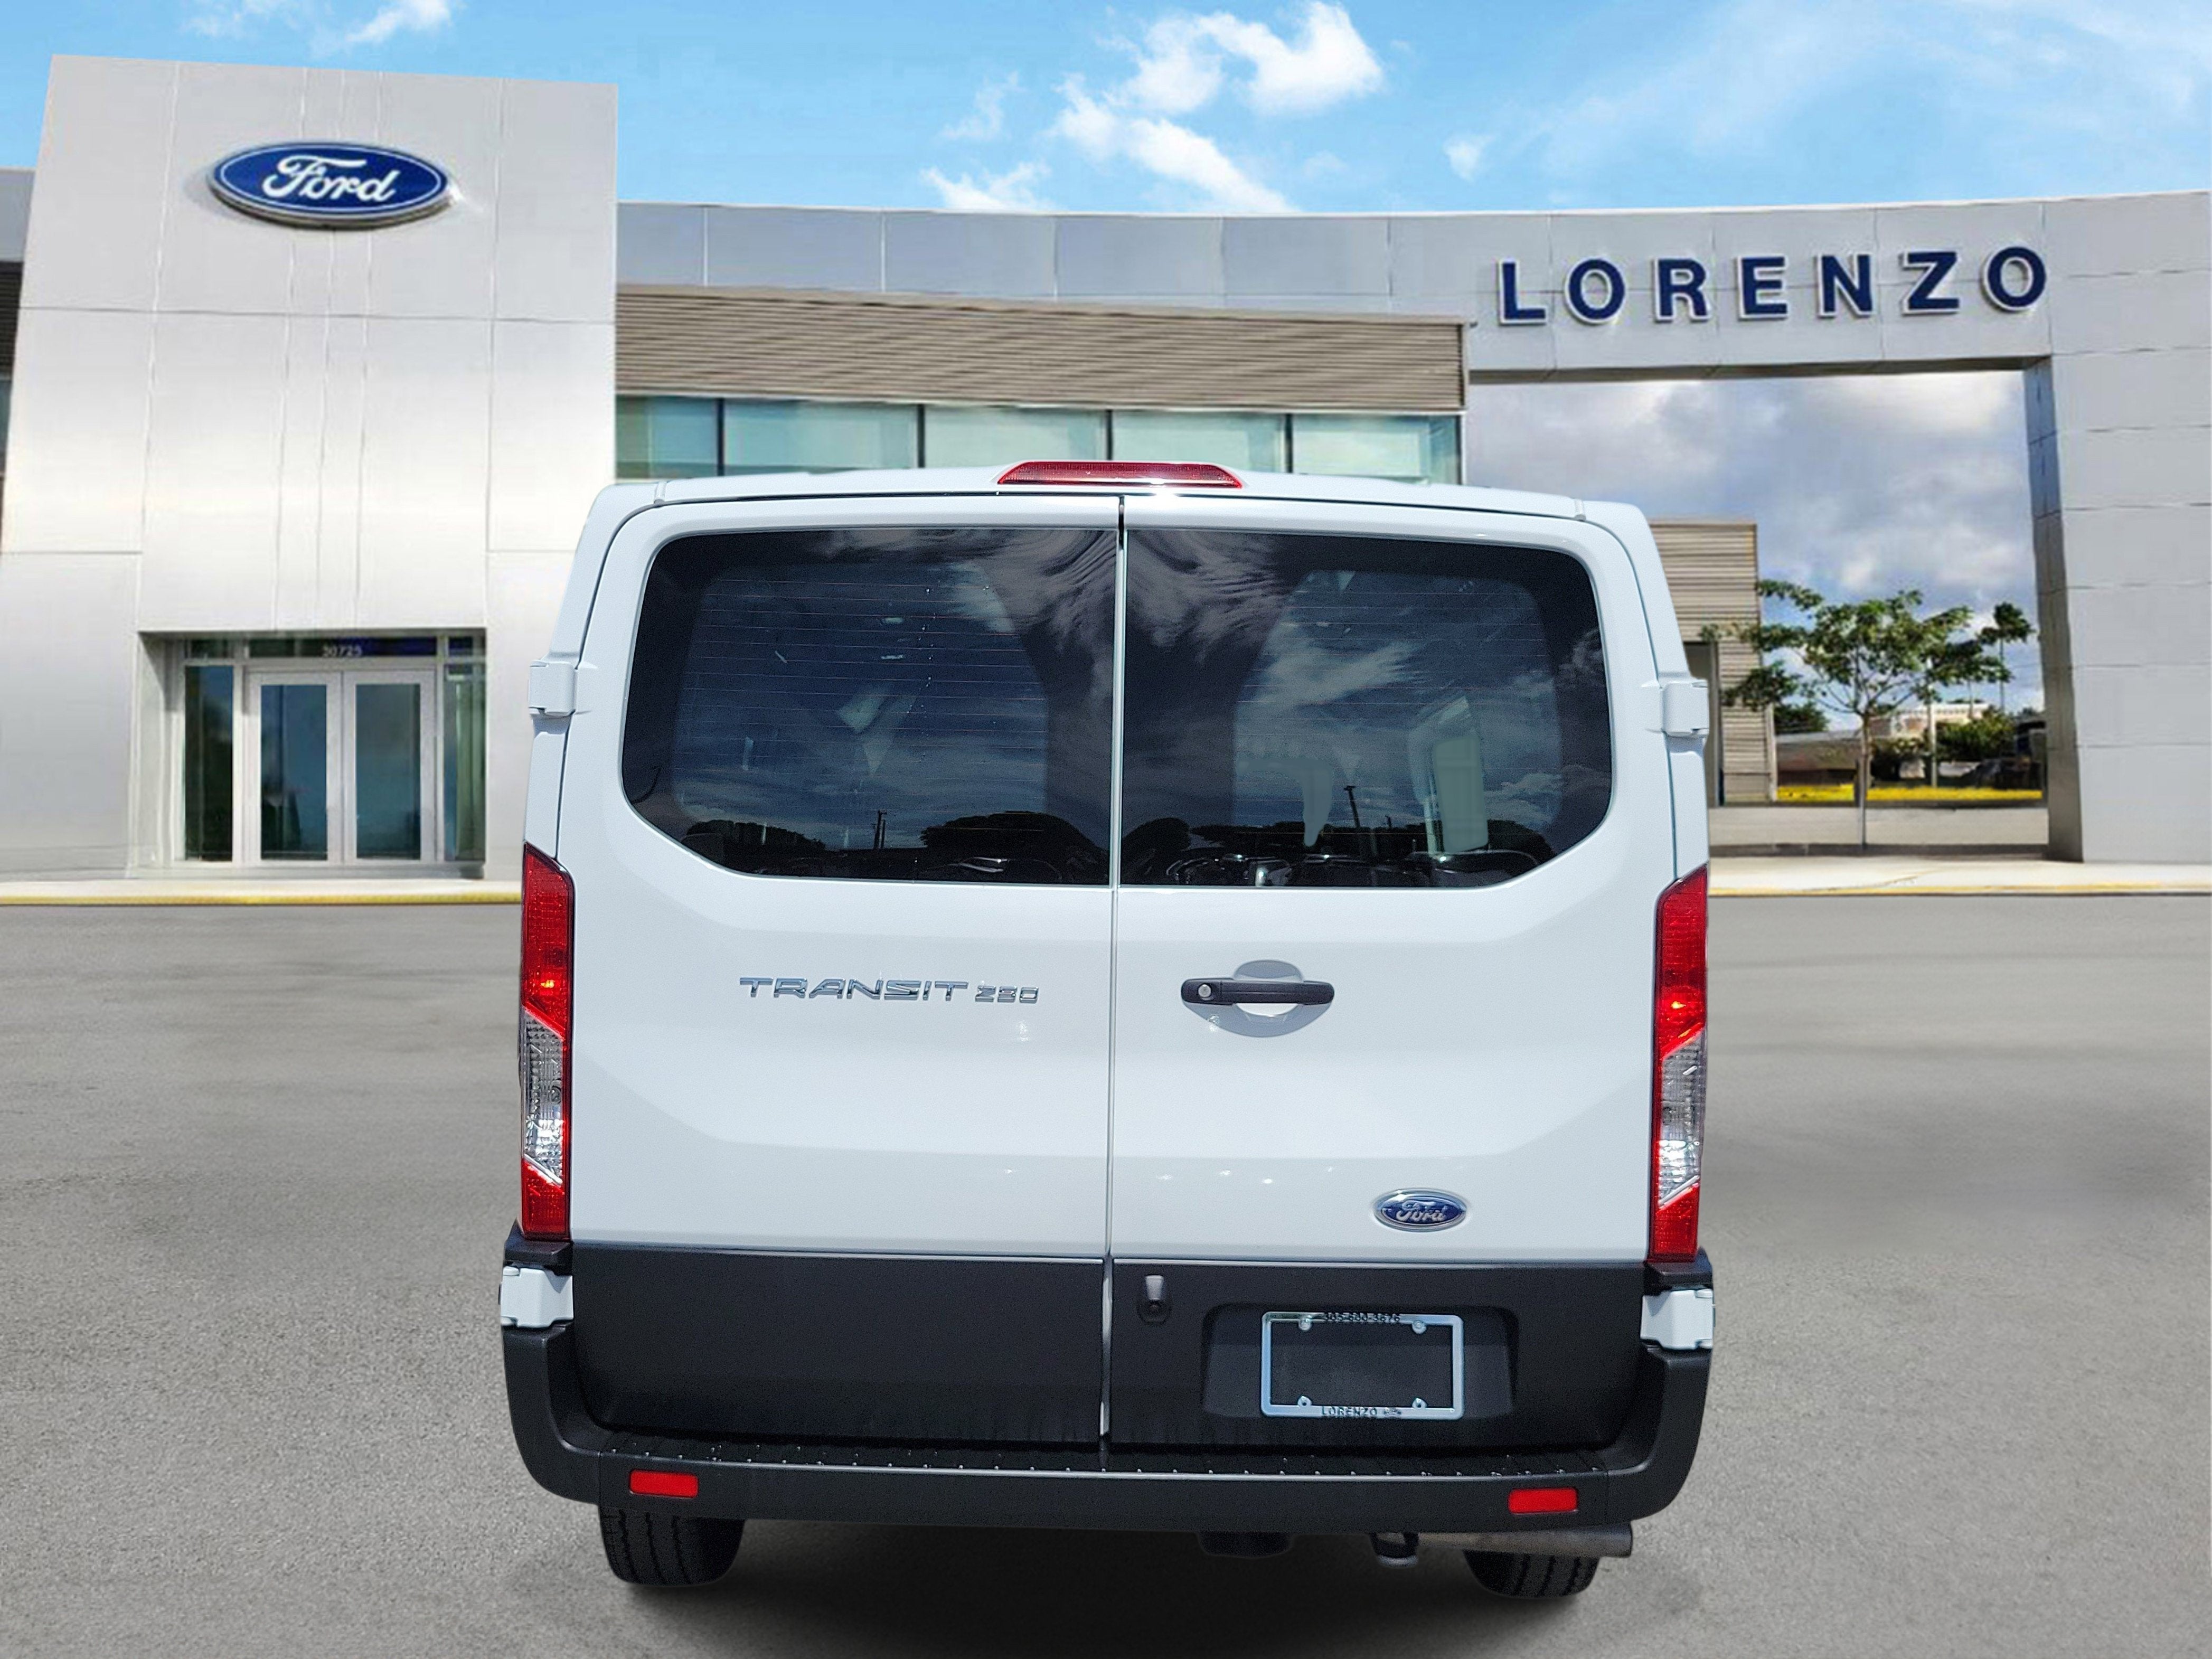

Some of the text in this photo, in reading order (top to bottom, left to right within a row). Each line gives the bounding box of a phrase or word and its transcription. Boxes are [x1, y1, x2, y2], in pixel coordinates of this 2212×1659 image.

[262, 154, 401, 202] Ford
[1498, 246, 2047, 325] LORENZO
[739, 977, 969, 1002] TRANSIT
[1396, 1200, 1447, 1222] Ford
[1321, 1406, 1378, 1418] LORENZO
